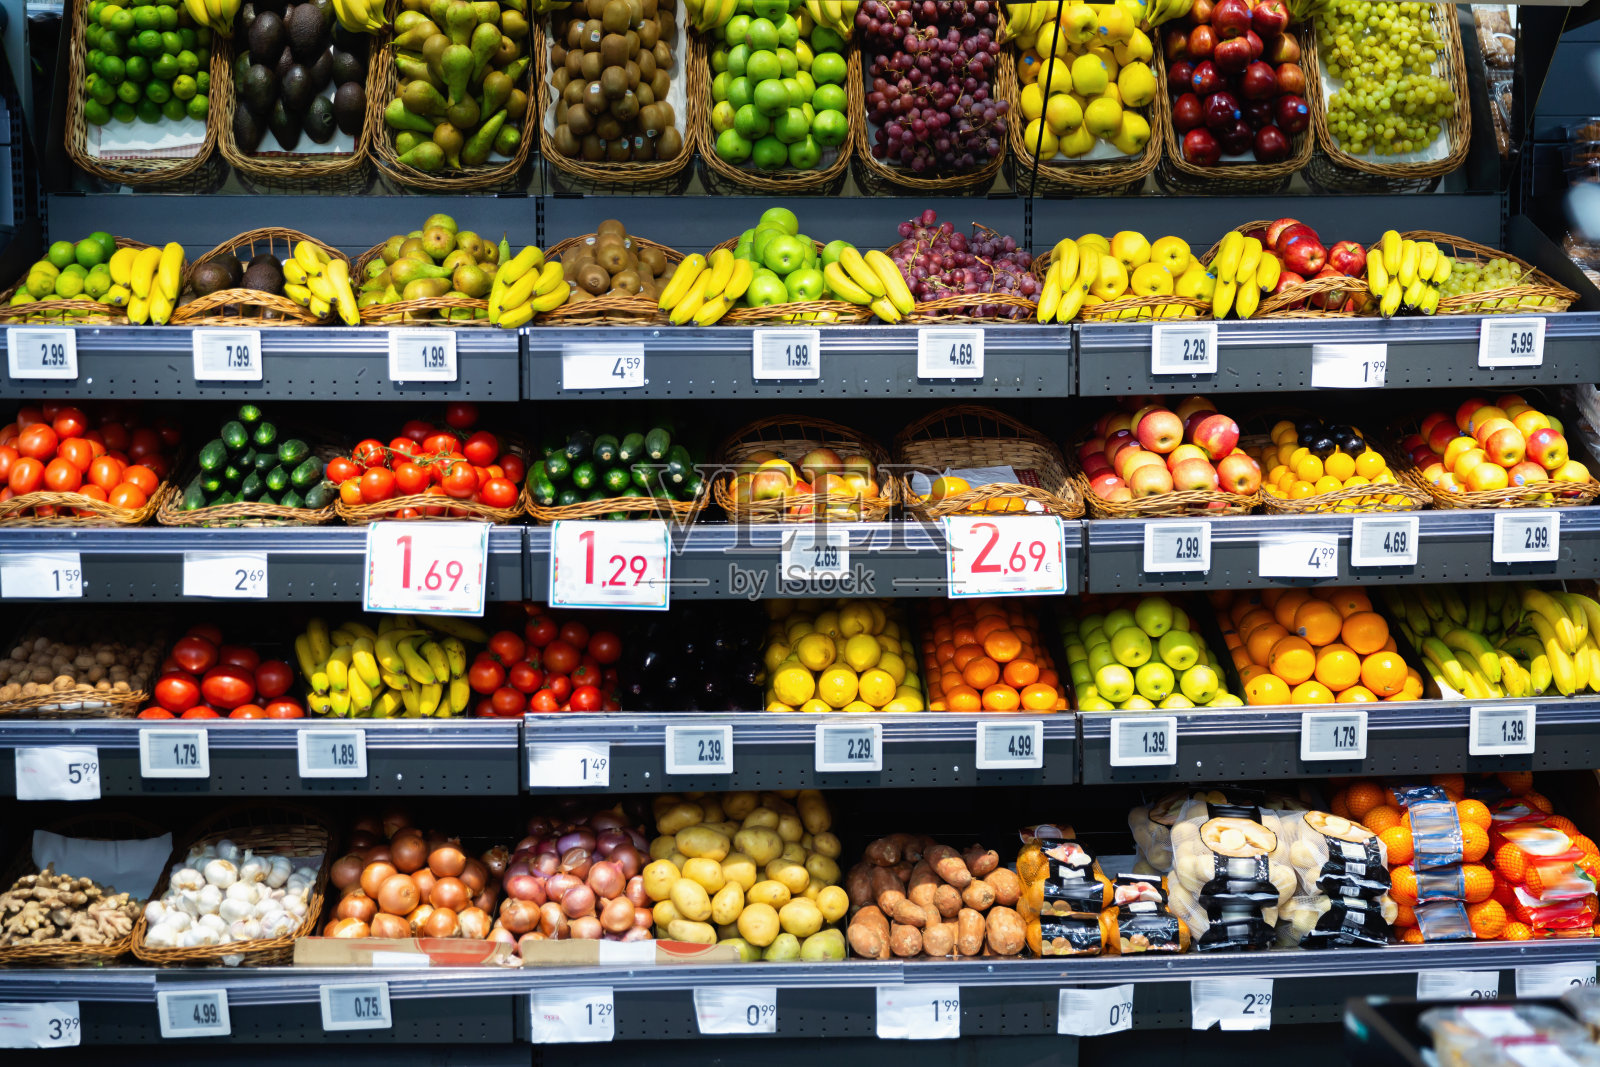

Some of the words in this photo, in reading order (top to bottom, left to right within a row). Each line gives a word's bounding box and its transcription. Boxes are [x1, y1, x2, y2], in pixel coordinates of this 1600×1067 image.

[1184, 339, 1204, 360] 2.29
[1511, 332, 1532, 353] 5.99
[42, 344, 64, 365] 2.99
[227, 346, 249, 367] 7.99
[422, 346, 444, 367] 1.99
[786, 345, 809, 366] 1.99
[950, 344, 973, 365] 4.69
[1176, 537, 1198, 558] 2.99
[1384, 532, 1407, 552] 4.69
[1525, 527, 1546, 548] 2.99
[815, 546, 838, 567] 2.69
[1334, 726, 1355, 747] 1.79
[1502, 720, 1523, 741] 1.39
[699, 740, 721, 761] 2.39
[848, 739, 870, 759] 2.29
[1009, 735, 1029, 756] 4.99
[1143, 732, 1163, 752] 1.39
[174, 744, 196, 764] 1.79
[332, 744, 354, 765] 1.89
[194, 1004, 216, 1024] 4.99
[355, 997, 378, 1017] 0.75
